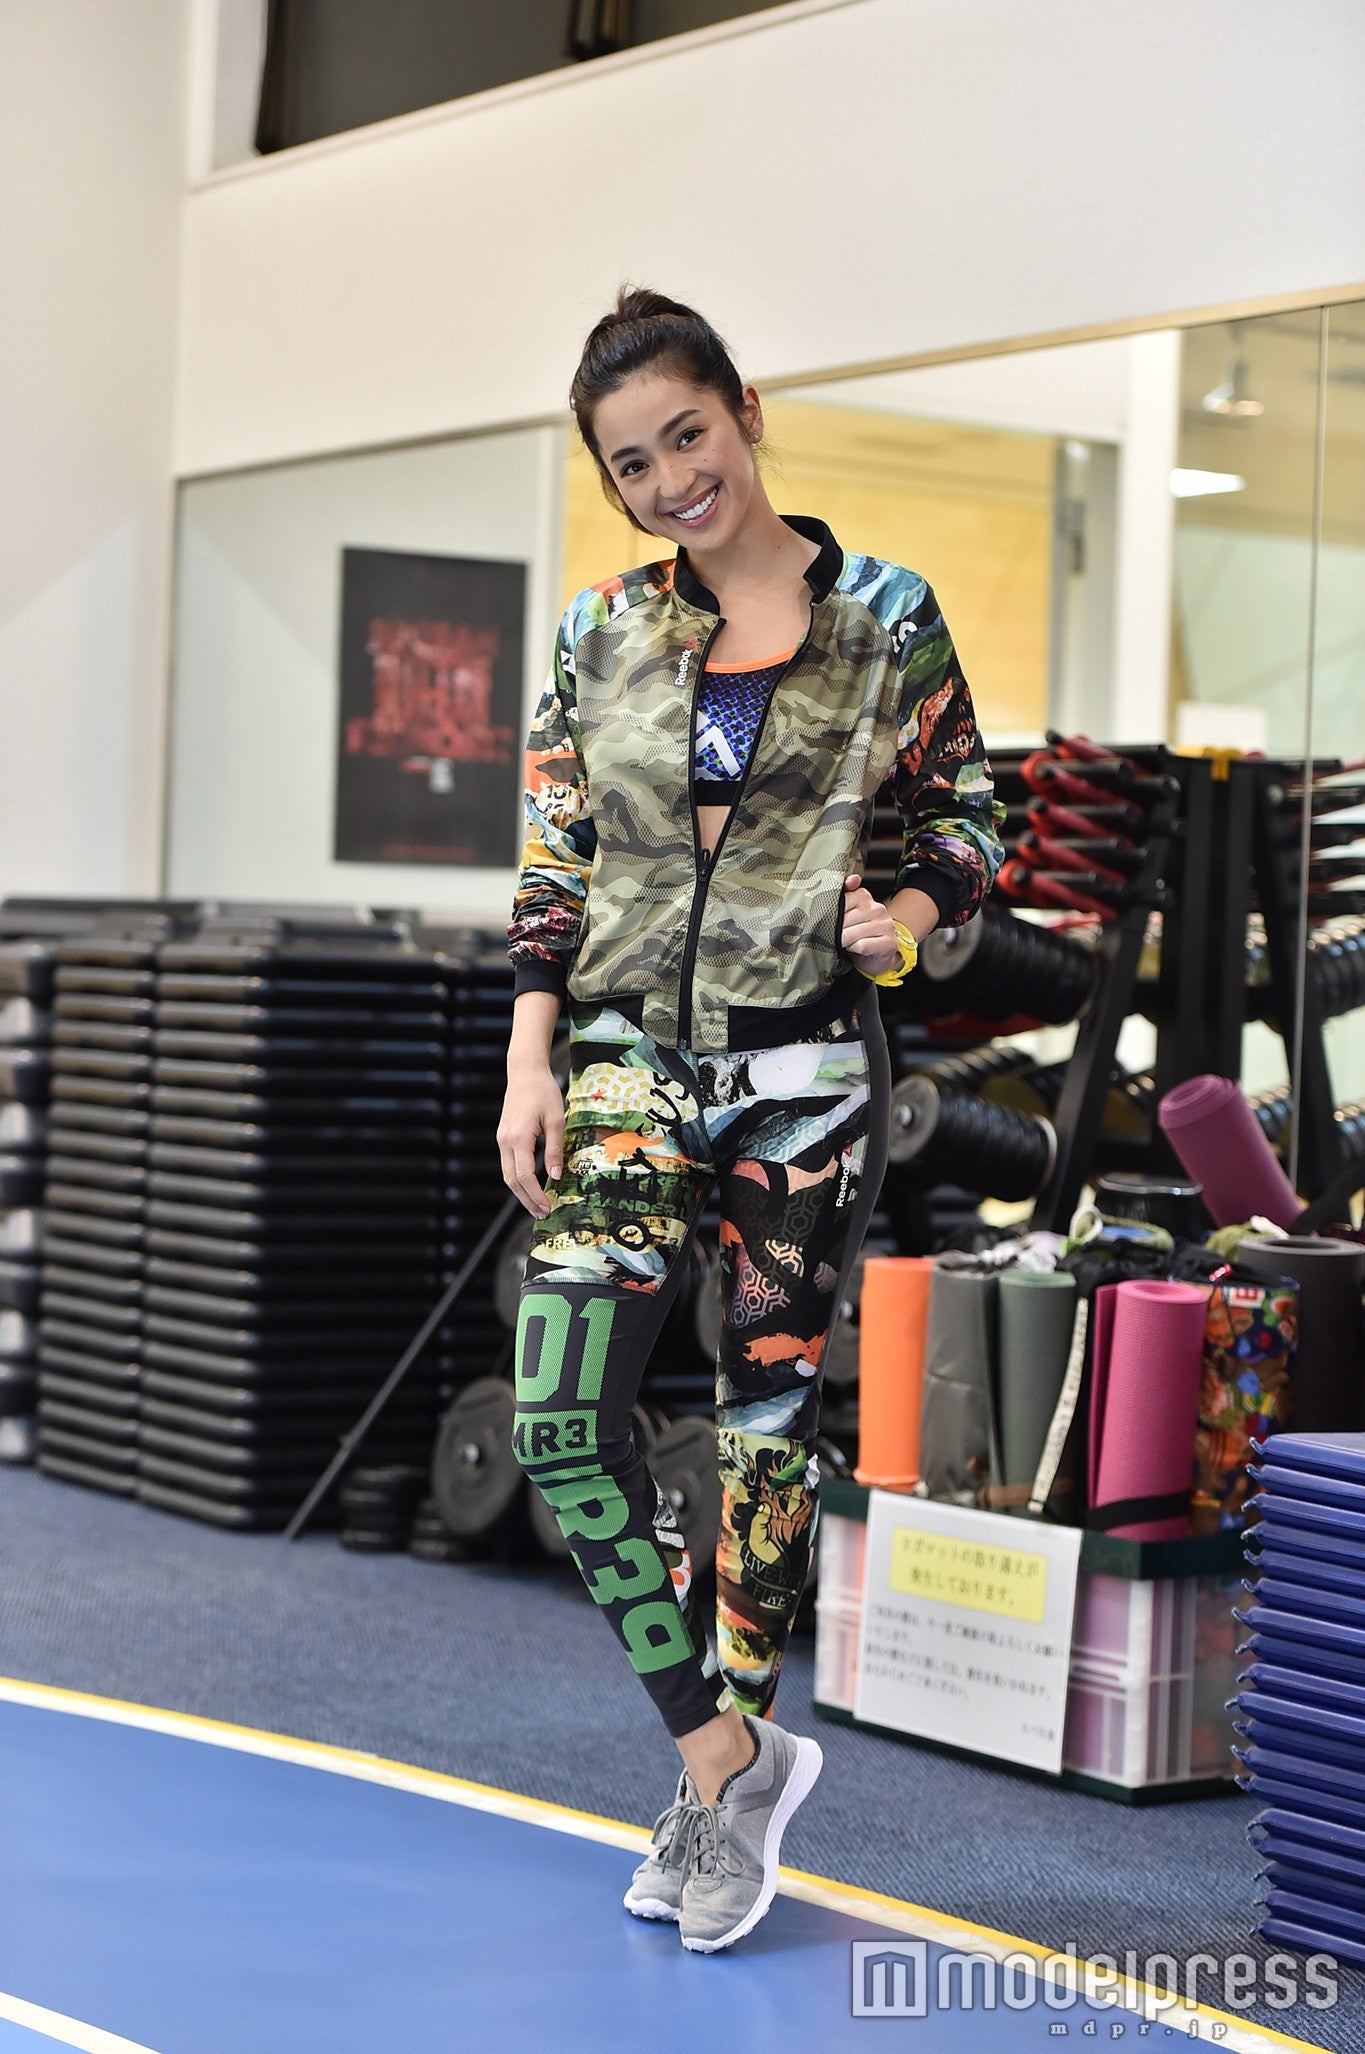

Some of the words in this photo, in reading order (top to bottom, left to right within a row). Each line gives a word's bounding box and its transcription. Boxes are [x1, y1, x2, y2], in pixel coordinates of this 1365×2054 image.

[674, 648, 694, 687] Reebok
[835, 1160, 851, 1208] Reebok
[515, 1292, 617, 1404] 01
